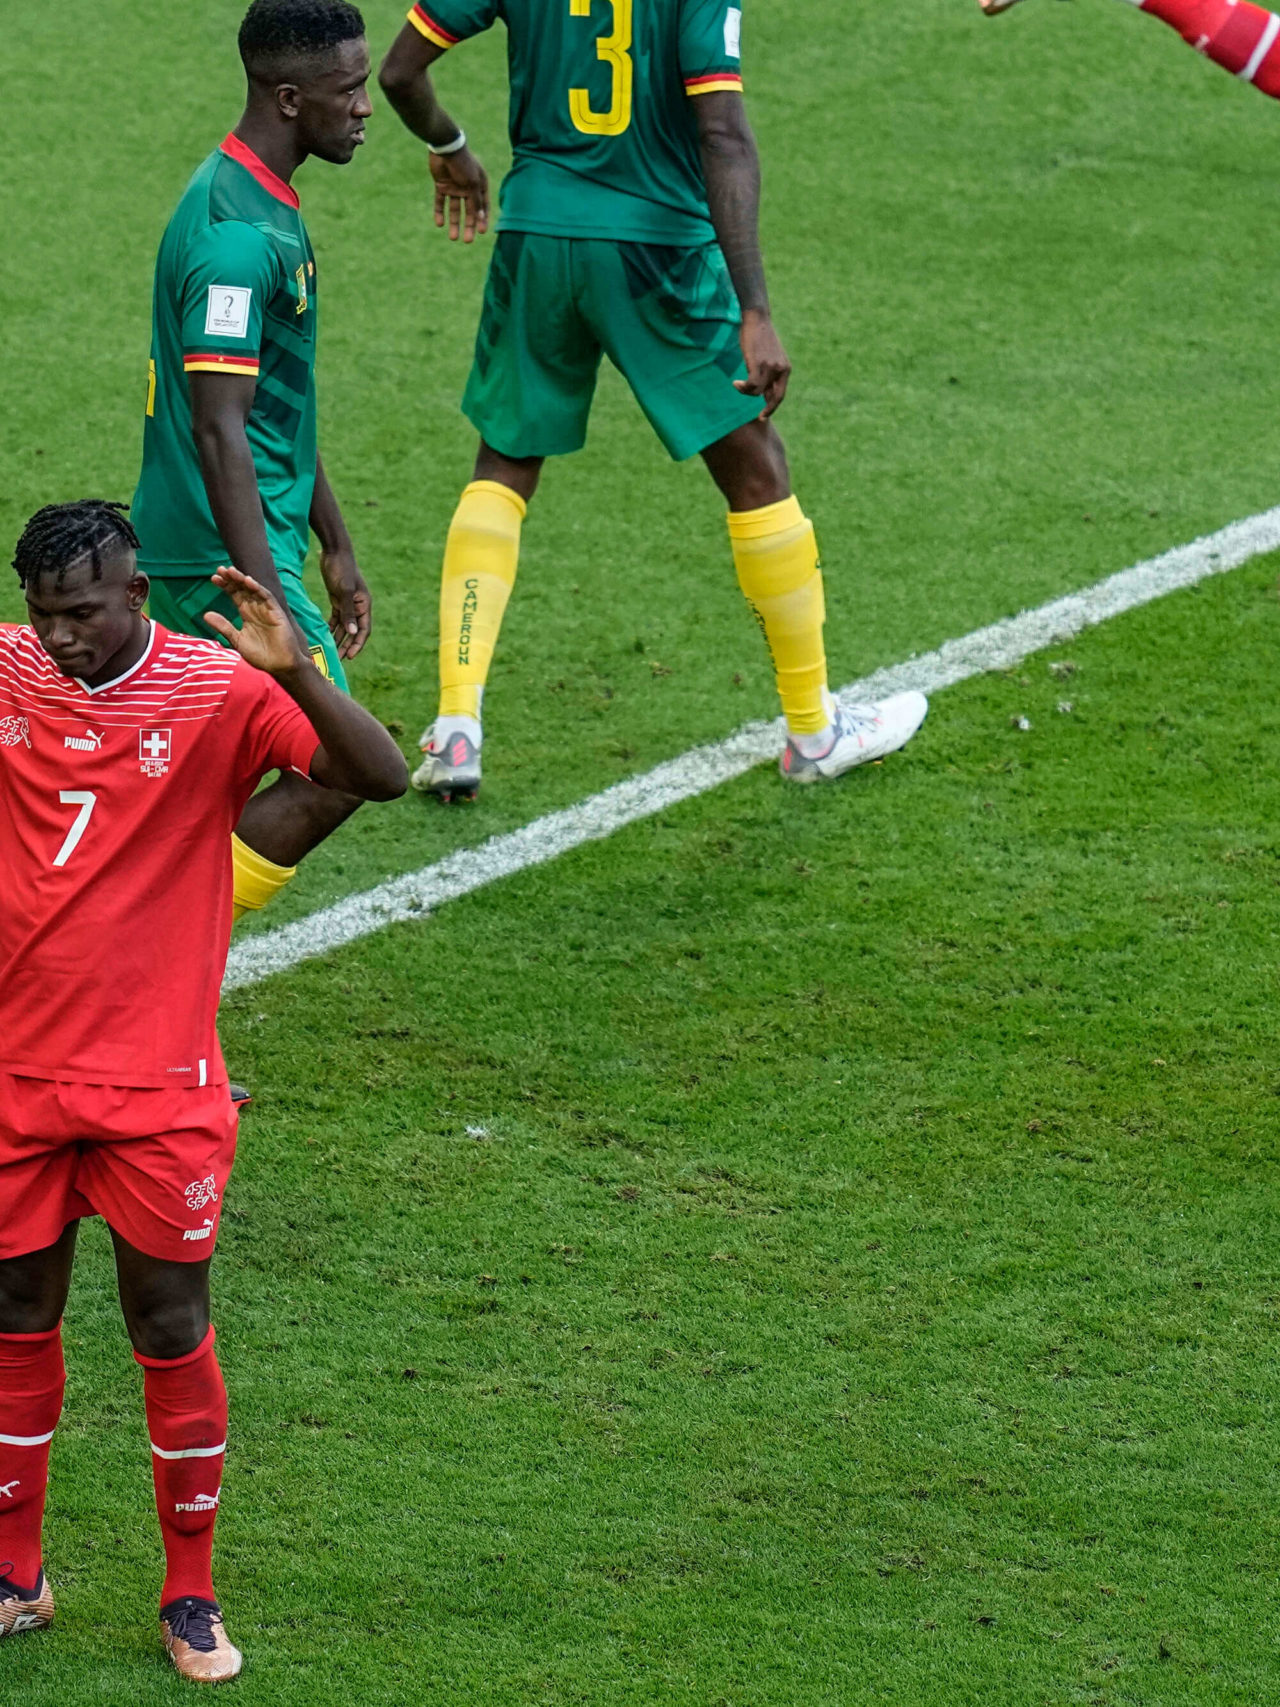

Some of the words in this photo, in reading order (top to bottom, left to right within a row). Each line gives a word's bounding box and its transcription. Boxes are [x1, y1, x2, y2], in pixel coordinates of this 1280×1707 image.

[568, 0, 633, 136] 3
[458, 578, 478, 665] CAMEROUN
[64, 736, 97, 752] PUMA
[53, 791, 97, 867] 7
[183, 1226, 211, 1240] PUMA
[175, 1501, 216, 1512] PUMA
